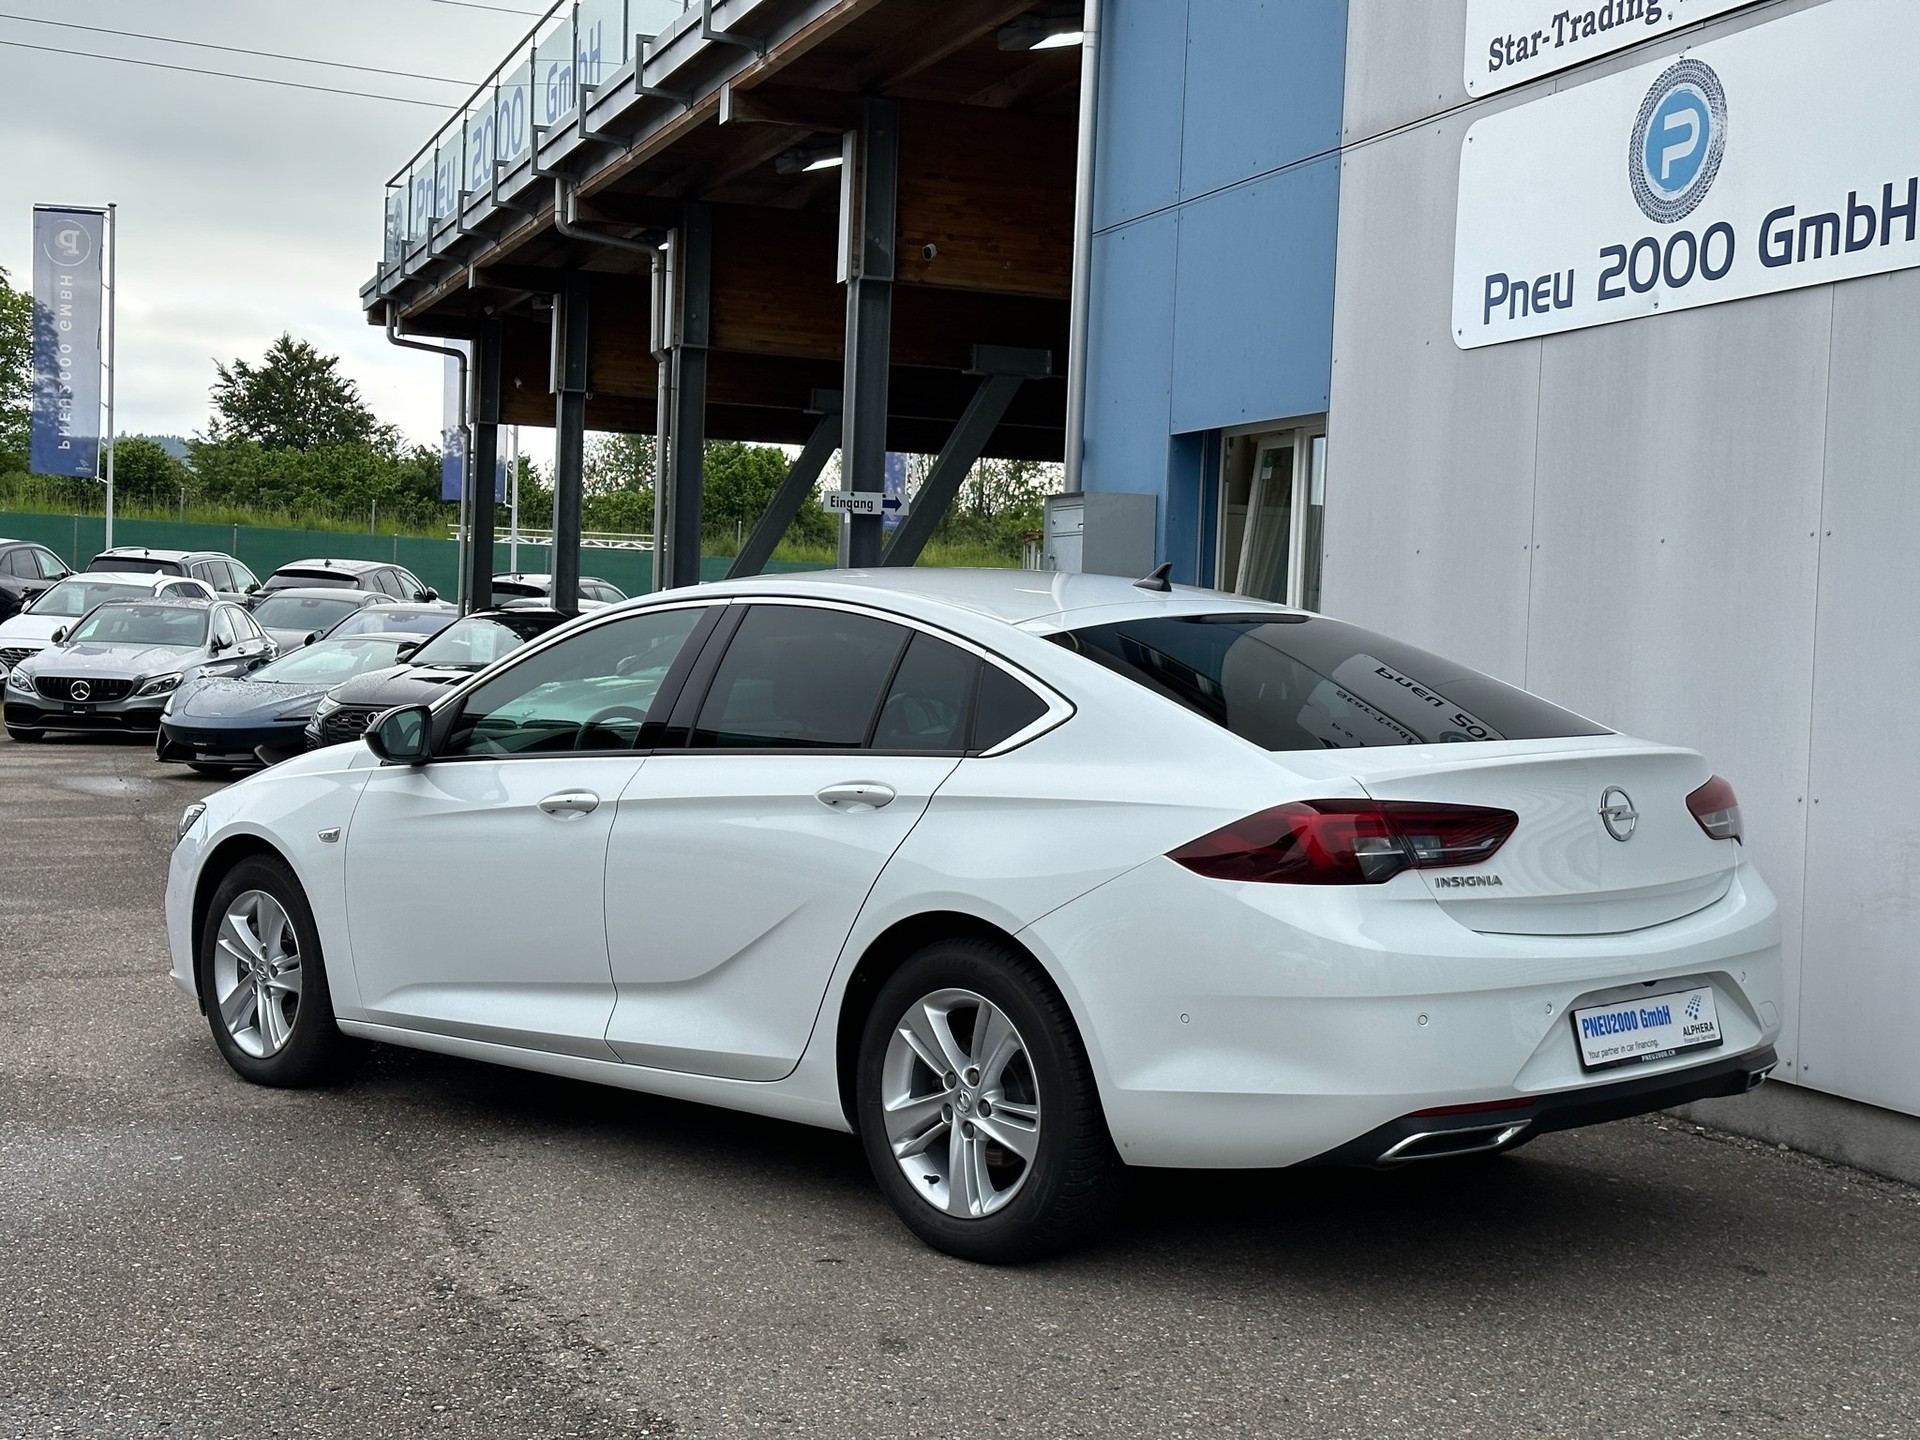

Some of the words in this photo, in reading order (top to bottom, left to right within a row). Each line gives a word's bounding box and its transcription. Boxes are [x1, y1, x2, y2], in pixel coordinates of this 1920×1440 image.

[415, 154, 455, 236] Pneu
[471, 86, 524, 192] 2000
[546, 19, 602, 125] GmbH
[1483, 268, 1575, 325] Pneu
[1598, 221, 1736, 302] 2000
[1758, 176, 1919, 269] GmbH
[830, 495, 874, 512] Eingang
[1434, 874, 1503, 889] INSIGNIA
[1582, 1010, 1638, 1039] PNEU2000
[1639, 1004, 1672, 1029] GmbH
[1682, 1021, 1715, 1037] ALPHERA
[1588, 1048, 1601, 1059] Your
[1601, 1045, 1619, 1058] partner
[1626, 1043, 1635, 1053] car
